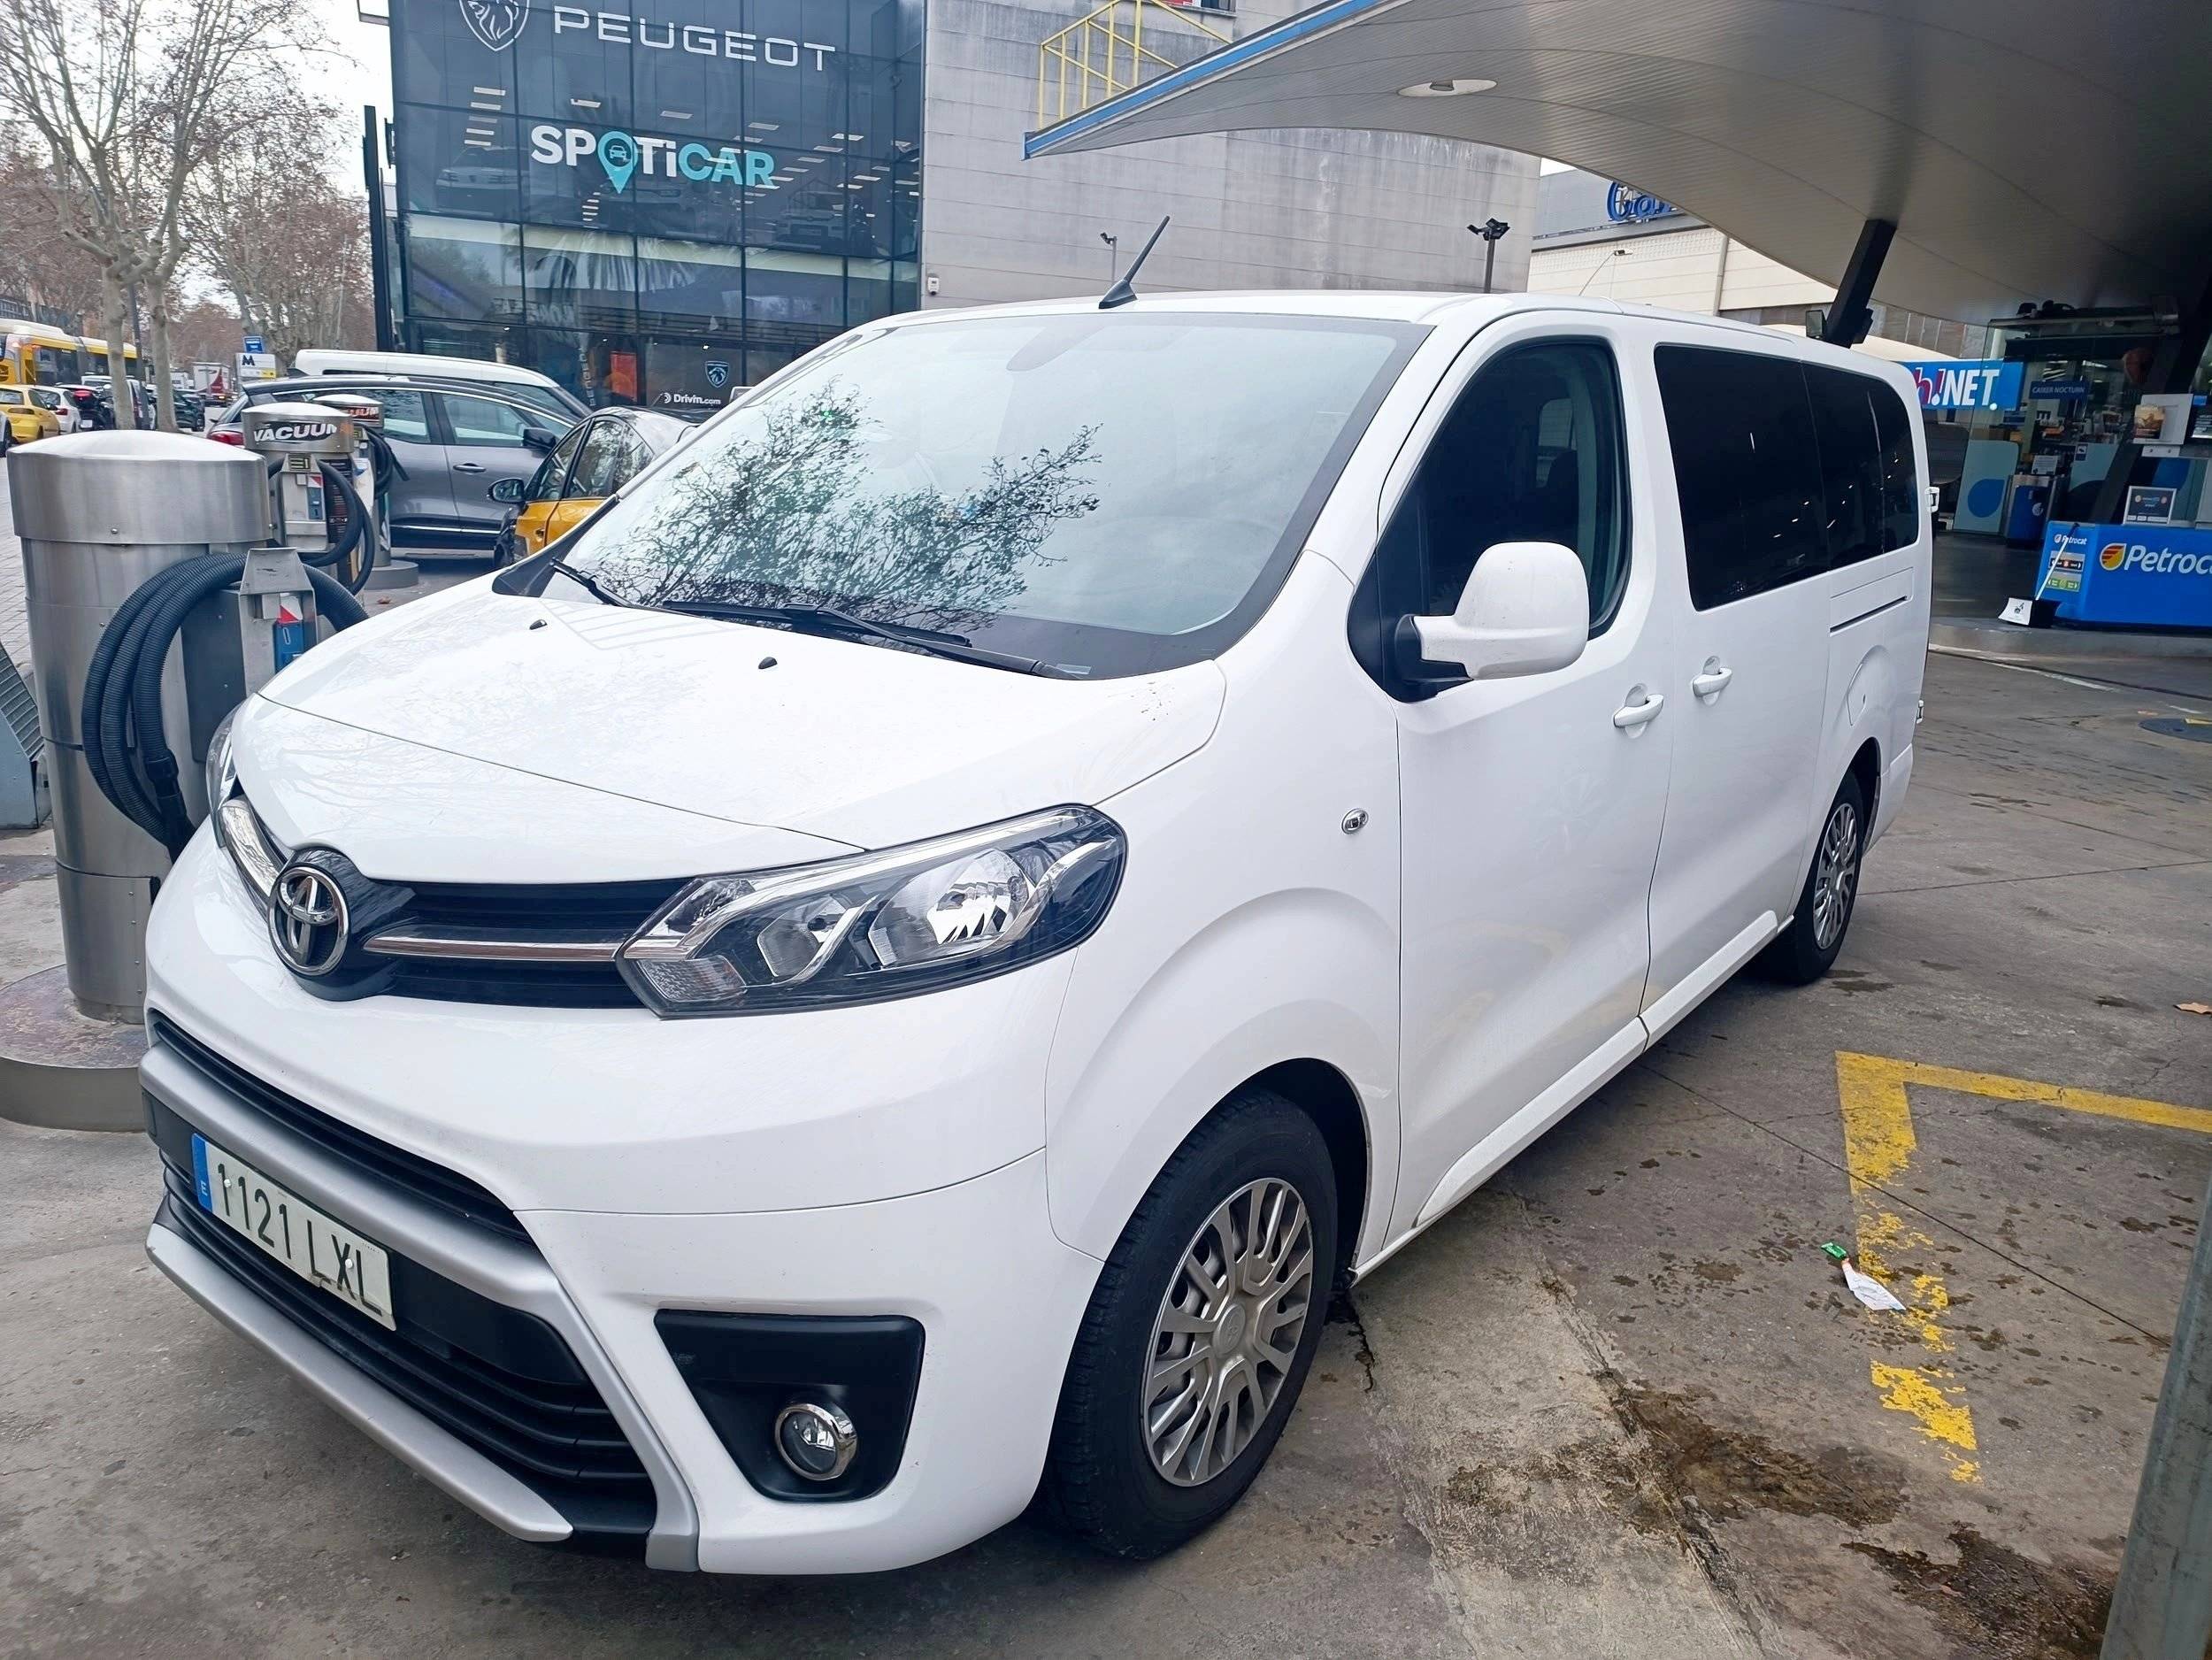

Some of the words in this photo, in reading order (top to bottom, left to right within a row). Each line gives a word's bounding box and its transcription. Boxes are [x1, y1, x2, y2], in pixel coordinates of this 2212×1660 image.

[554, 5, 835, 71] PEUGEOT
[242, 355, 255, 366] M
[673, 394, 721, 404] Drivin.com
[2124, 545, 2212, 574] Petroc
[201, 1180, 208, 1196] E
[218, 1163, 292, 1260] 1121
[307, 1219, 383, 1317] LXL
